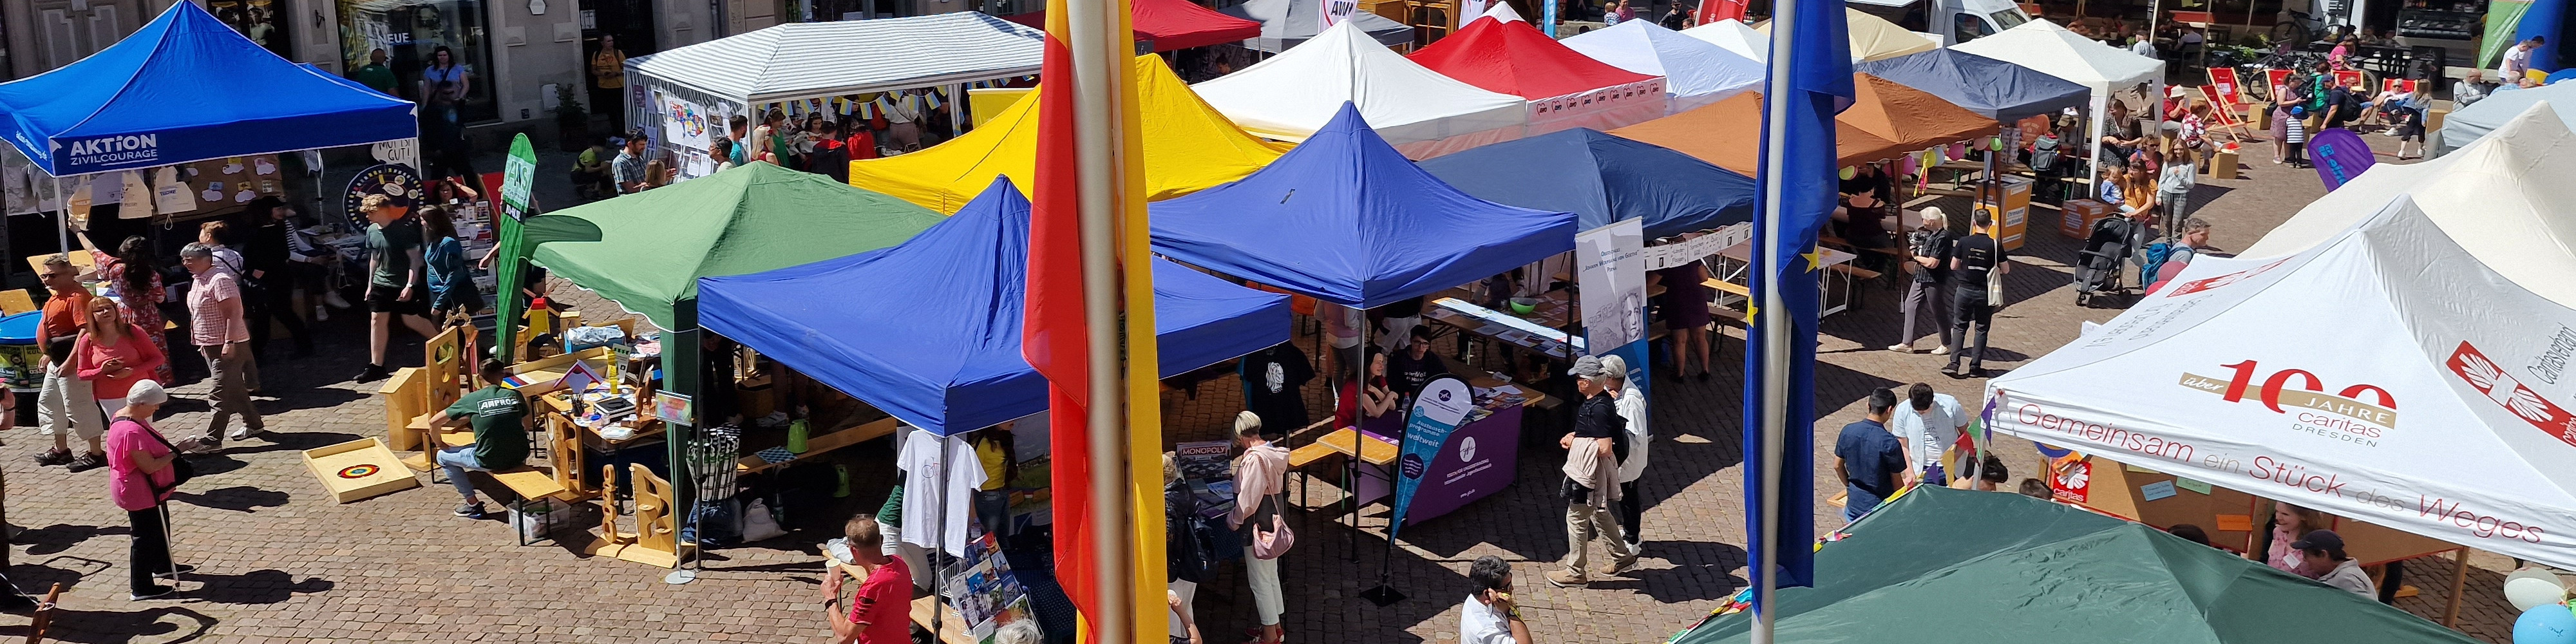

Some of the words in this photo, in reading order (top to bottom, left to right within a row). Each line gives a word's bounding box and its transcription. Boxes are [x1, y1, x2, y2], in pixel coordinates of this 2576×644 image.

[70, 149, 158, 166] ZIVILCOURAGE
[388, 147, 410, 161] GUT!
[2183, 376, 2224, 391] über
[2220, 359, 2397, 414] 100
[2304, 397, 2390, 424] JAHRE
[1416, 420, 1447, 433] Austausch-
[2298, 412, 2382, 439] caritas
[1407, 431, 1439, 448] weltweit
[2292, 423, 2378, 448] DRESDEN
[1182, 446, 1226, 455] MONOPOLY
[2018, 403, 2194, 462] Gemeinsam
[2203, 450, 2240, 473] ein
[2248, 455, 2347, 498] Stück
[2355, 489, 2406, 512] des
[2419, 493, 2545, 544] Weges
[2053, 488, 2085, 502] caritas
